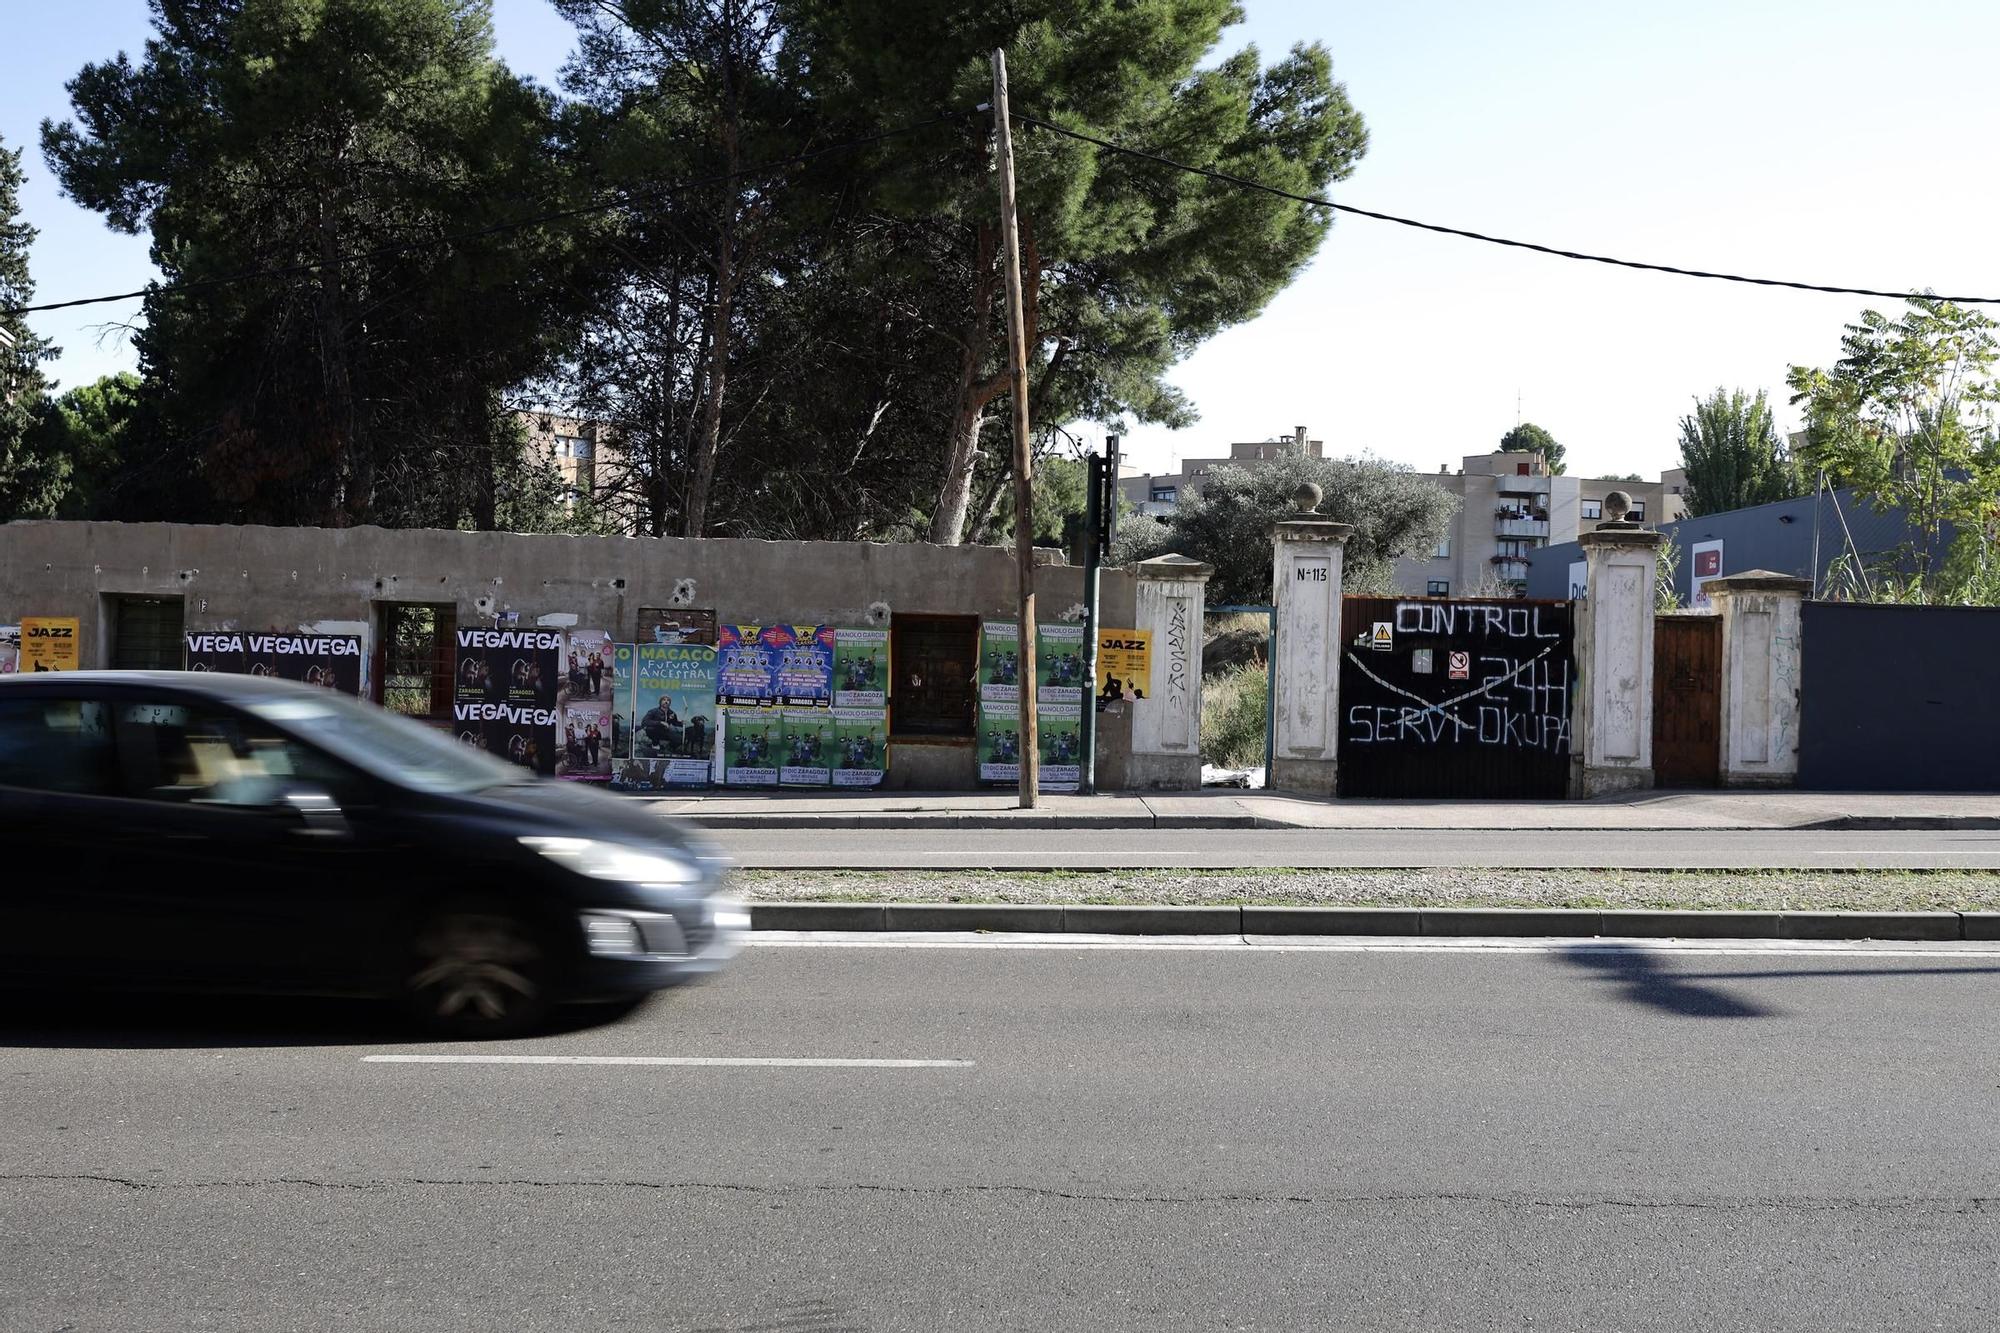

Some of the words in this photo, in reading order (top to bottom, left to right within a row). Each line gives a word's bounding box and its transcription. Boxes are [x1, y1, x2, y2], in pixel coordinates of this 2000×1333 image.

[1396, 603, 1560, 638] CONTROL
[27, 627, 73, 638] JAZZ
[457, 630, 510, 648] VEGA
[508, 631, 560, 650] VEGA
[187, 635, 244, 653] VEGA
[247, 635, 304, 654] VEGA
[302, 637, 360, 656] VEGA
[1101, 639, 1146, 651] JAZZ
[641, 647, 715, 661] MACACO
[640, 667, 715, 680] ANCESTRAL
[648, 659, 700, 670] FUTURO
[640, 679, 680, 689] TOUR
[1480, 657, 1568, 718] 24H
[454, 703, 508, 721] VEGA
[506, 706, 557, 726] VEGA
[1480, 706, 1571, 754] OKUPA
